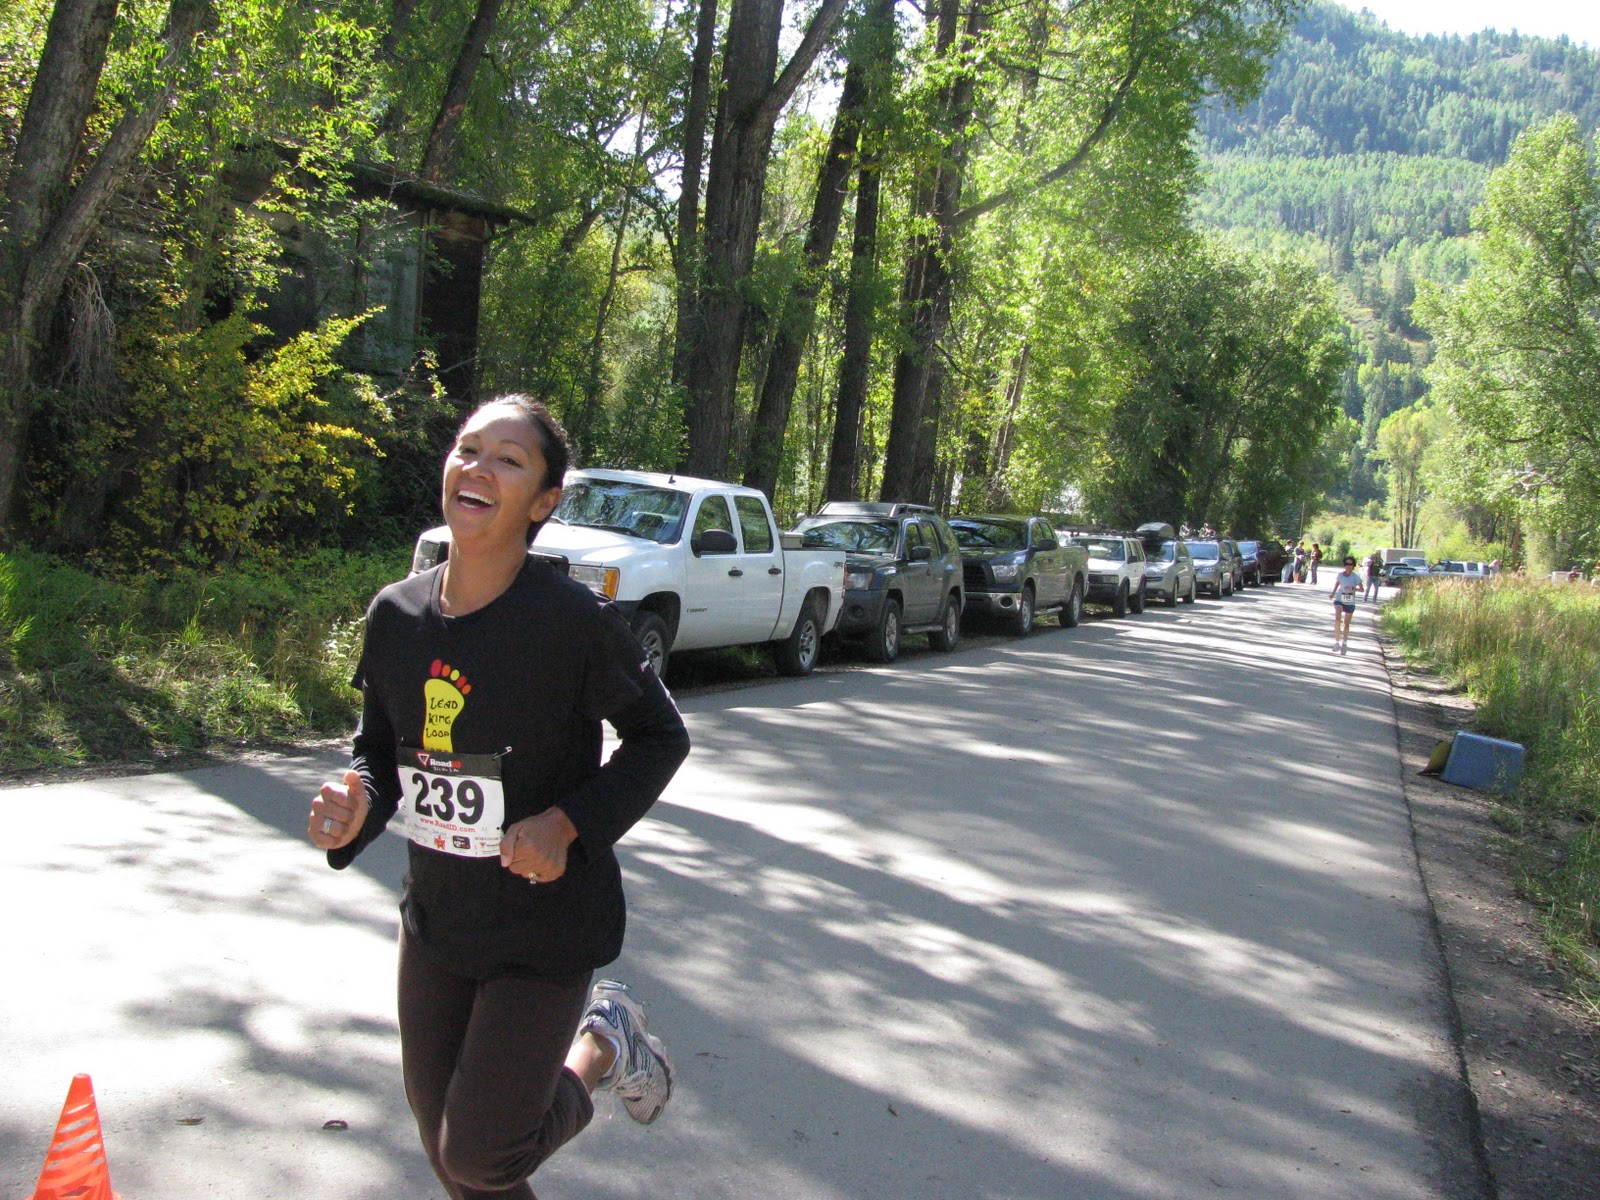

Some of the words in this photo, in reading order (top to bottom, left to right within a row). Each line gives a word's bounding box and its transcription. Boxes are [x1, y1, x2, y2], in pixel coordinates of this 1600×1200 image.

[430, 697, 458, 710] LEAD
[428, 713, 451, 725] KING
[426, 727, 449, 738] LOOP
[412, 773, 485, 826] 239
[419, 817, 476, 832] www.RoadID.com
